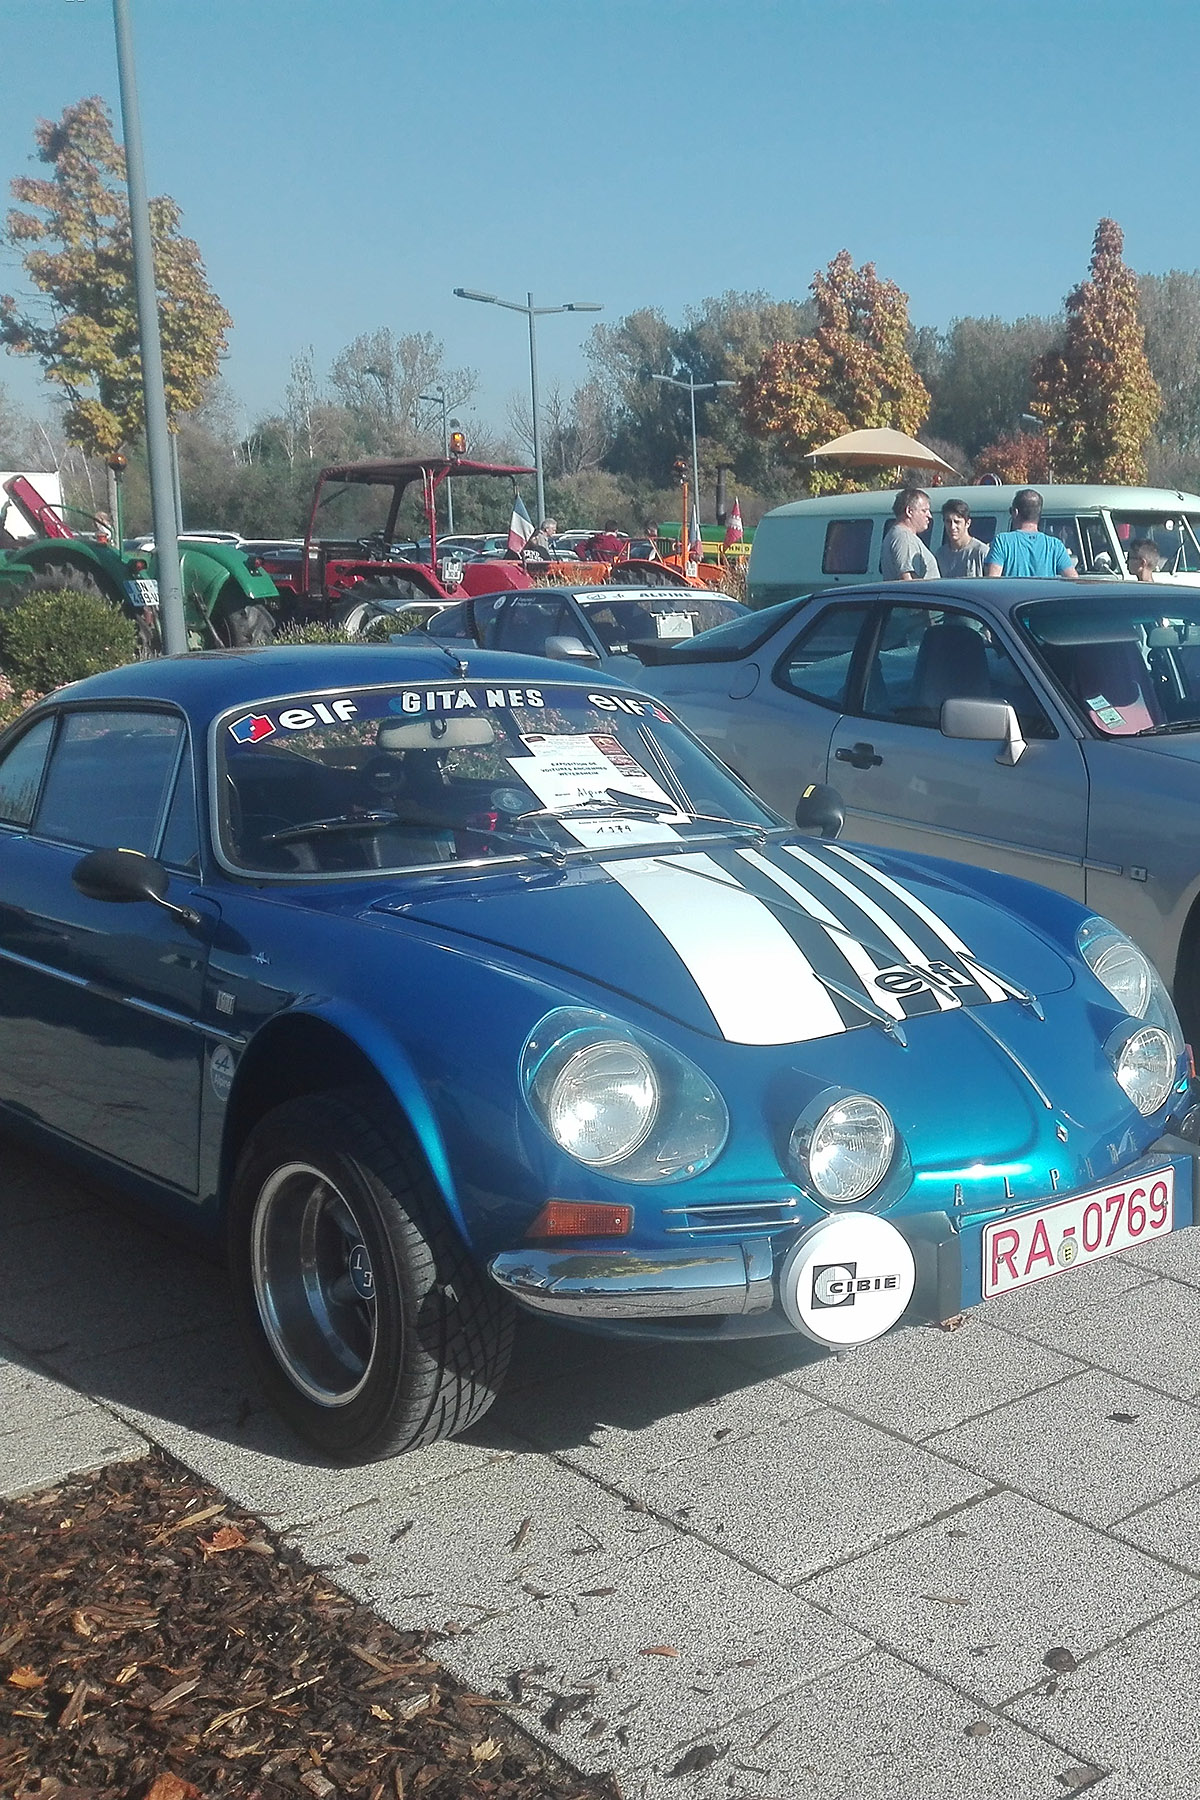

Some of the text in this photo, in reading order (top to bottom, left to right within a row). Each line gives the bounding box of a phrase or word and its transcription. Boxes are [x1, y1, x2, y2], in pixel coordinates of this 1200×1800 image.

[279, 699, 358, 730] elf
[587, 693, 648, 716] elf
[577, 787, 607, 799] Alpin
[874, 962, 964, 994] elf
[991, 1180, 1168, 1287] RA-0769
[829, 1276, 897, 1294] CIBIE
